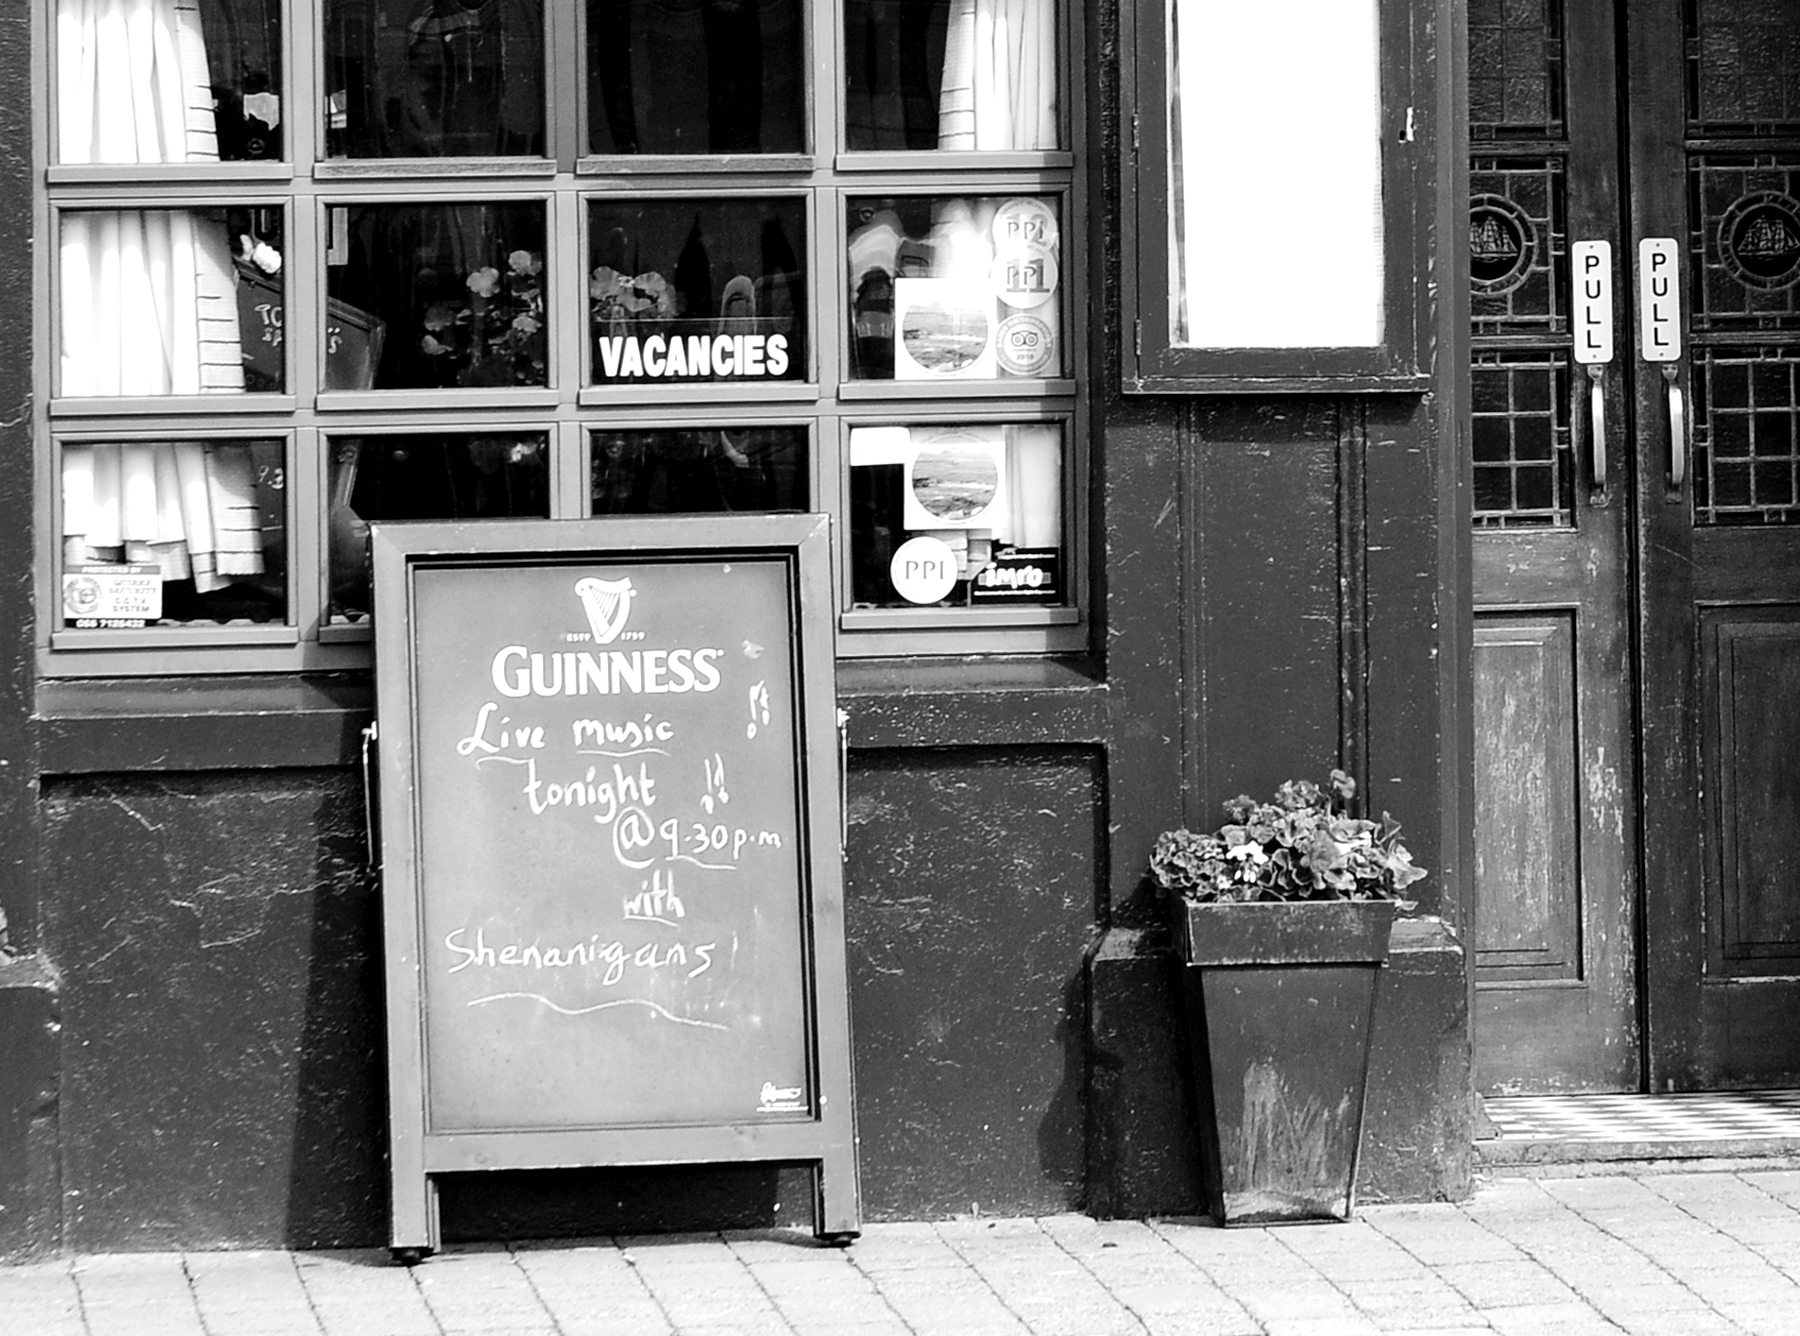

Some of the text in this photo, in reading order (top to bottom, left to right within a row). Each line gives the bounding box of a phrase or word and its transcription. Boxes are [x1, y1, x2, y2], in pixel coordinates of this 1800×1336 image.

[1585, 254, 1602, 349] PULL
[1651, 252, 1669, 347] PULL
[599, 333, 789, 377] VACANCIES
[906, 560, 944, 580] PPI
[984, 562, 1043, 589] imro
[491, 644, 723, 698] GUINNESS
[456, 701, 674, 755] Live music
[524, 758, 656, 824] tonight
[623, 870, 685, 920] with
[445, 928, 716, 986] Shenanigans
